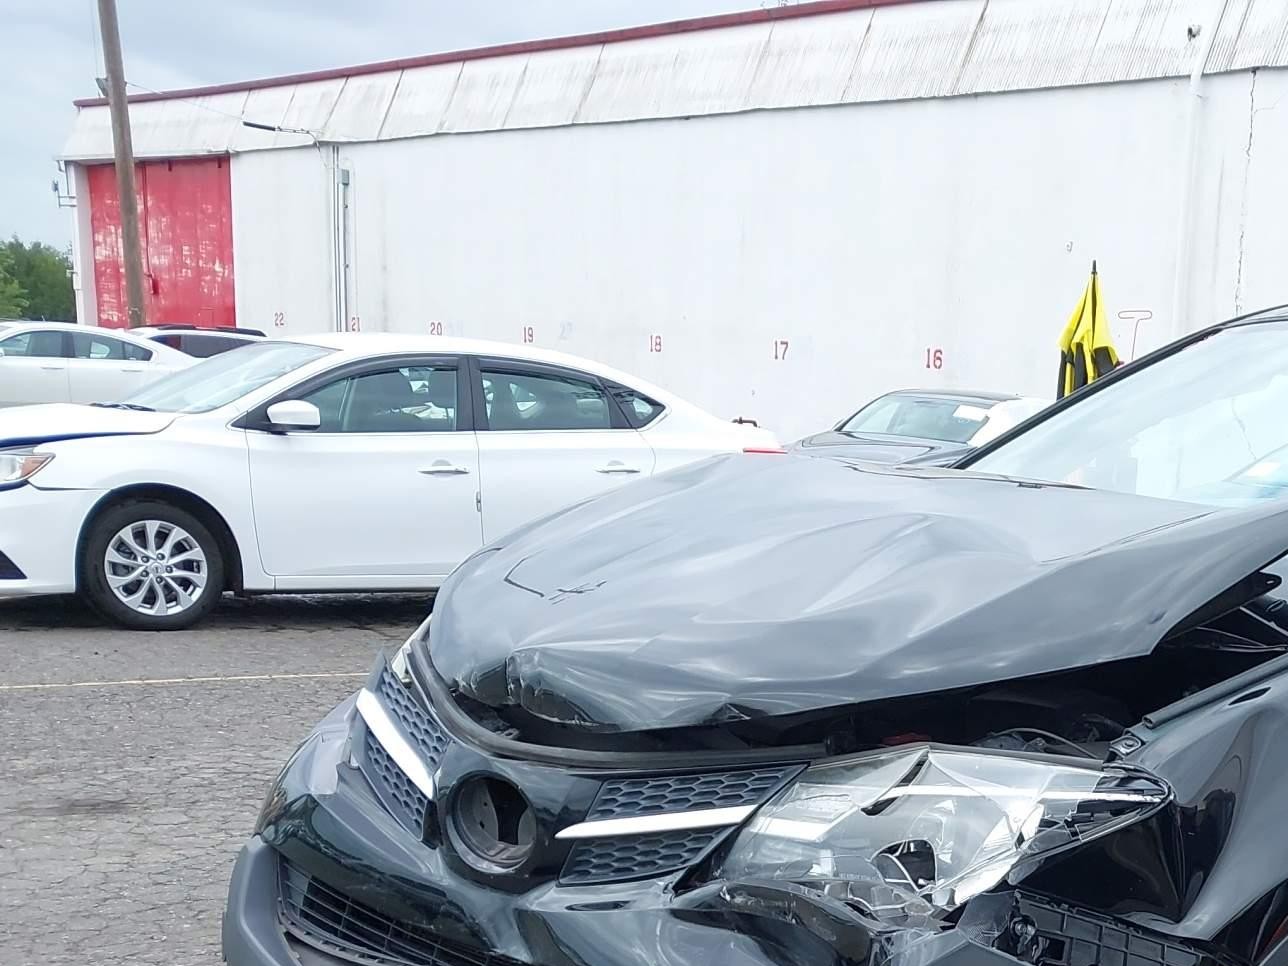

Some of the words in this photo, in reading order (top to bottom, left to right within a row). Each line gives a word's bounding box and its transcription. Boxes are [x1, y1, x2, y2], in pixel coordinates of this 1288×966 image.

[274, 312, 284, 327] 22
[351, 317, 361, 332] 21
[430, 322, 443, 336] 20
[523, 327, 534, 343] 19
[649, 334, 662, 353] 18
[774, 340, 789, 360] 17
[925, 348, 943, 370] 16
